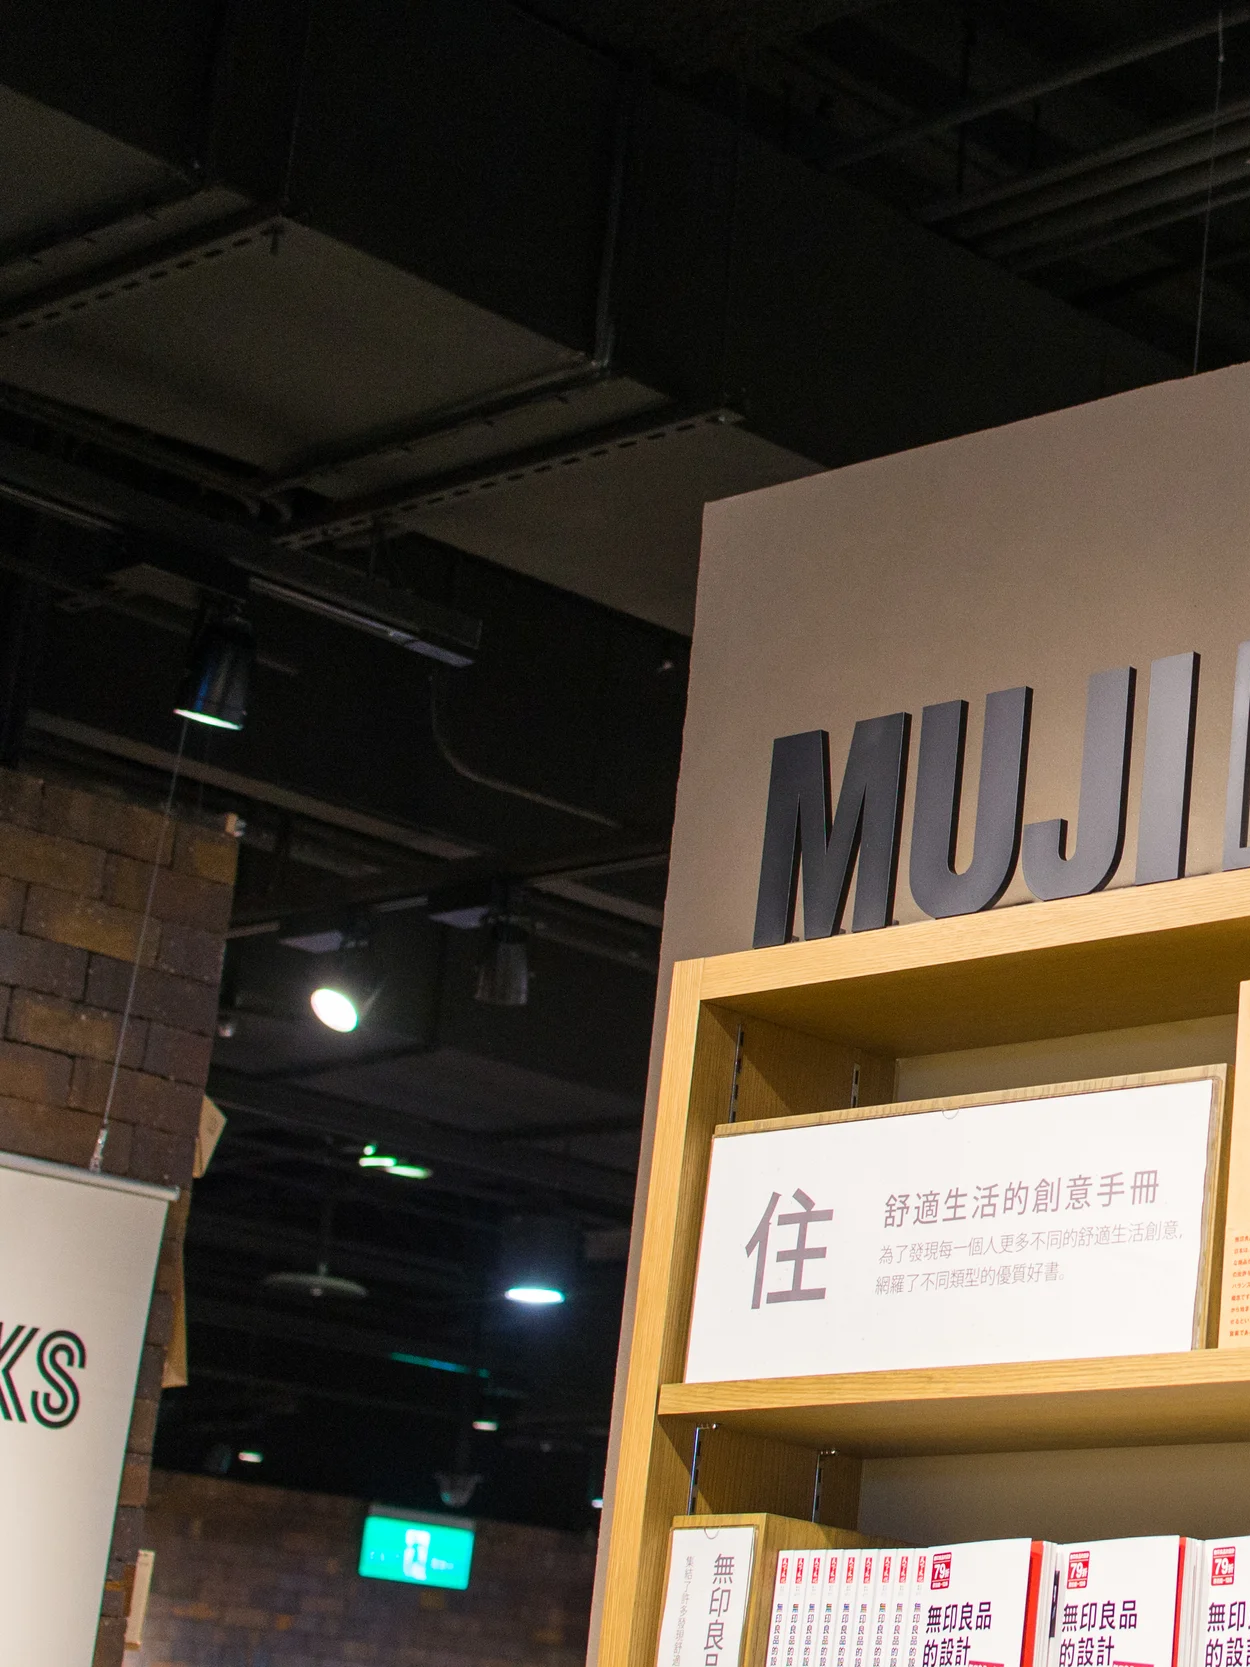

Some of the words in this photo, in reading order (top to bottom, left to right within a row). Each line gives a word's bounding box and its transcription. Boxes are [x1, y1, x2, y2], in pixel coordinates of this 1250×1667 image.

[752, 652, 1200, 948] MUJI
[883, 1169, 1160, 1228] 舒適生活的創意手冊
[745, 1188, 834, 1309] 住
[926, 1601, 992, 1633] 無印良品
[1061, 1600, 1138, 1632] 無印良品
[922, 1636, 971, 1667] 的設計
[1059, 1635, 1115, 1667] 的設計
